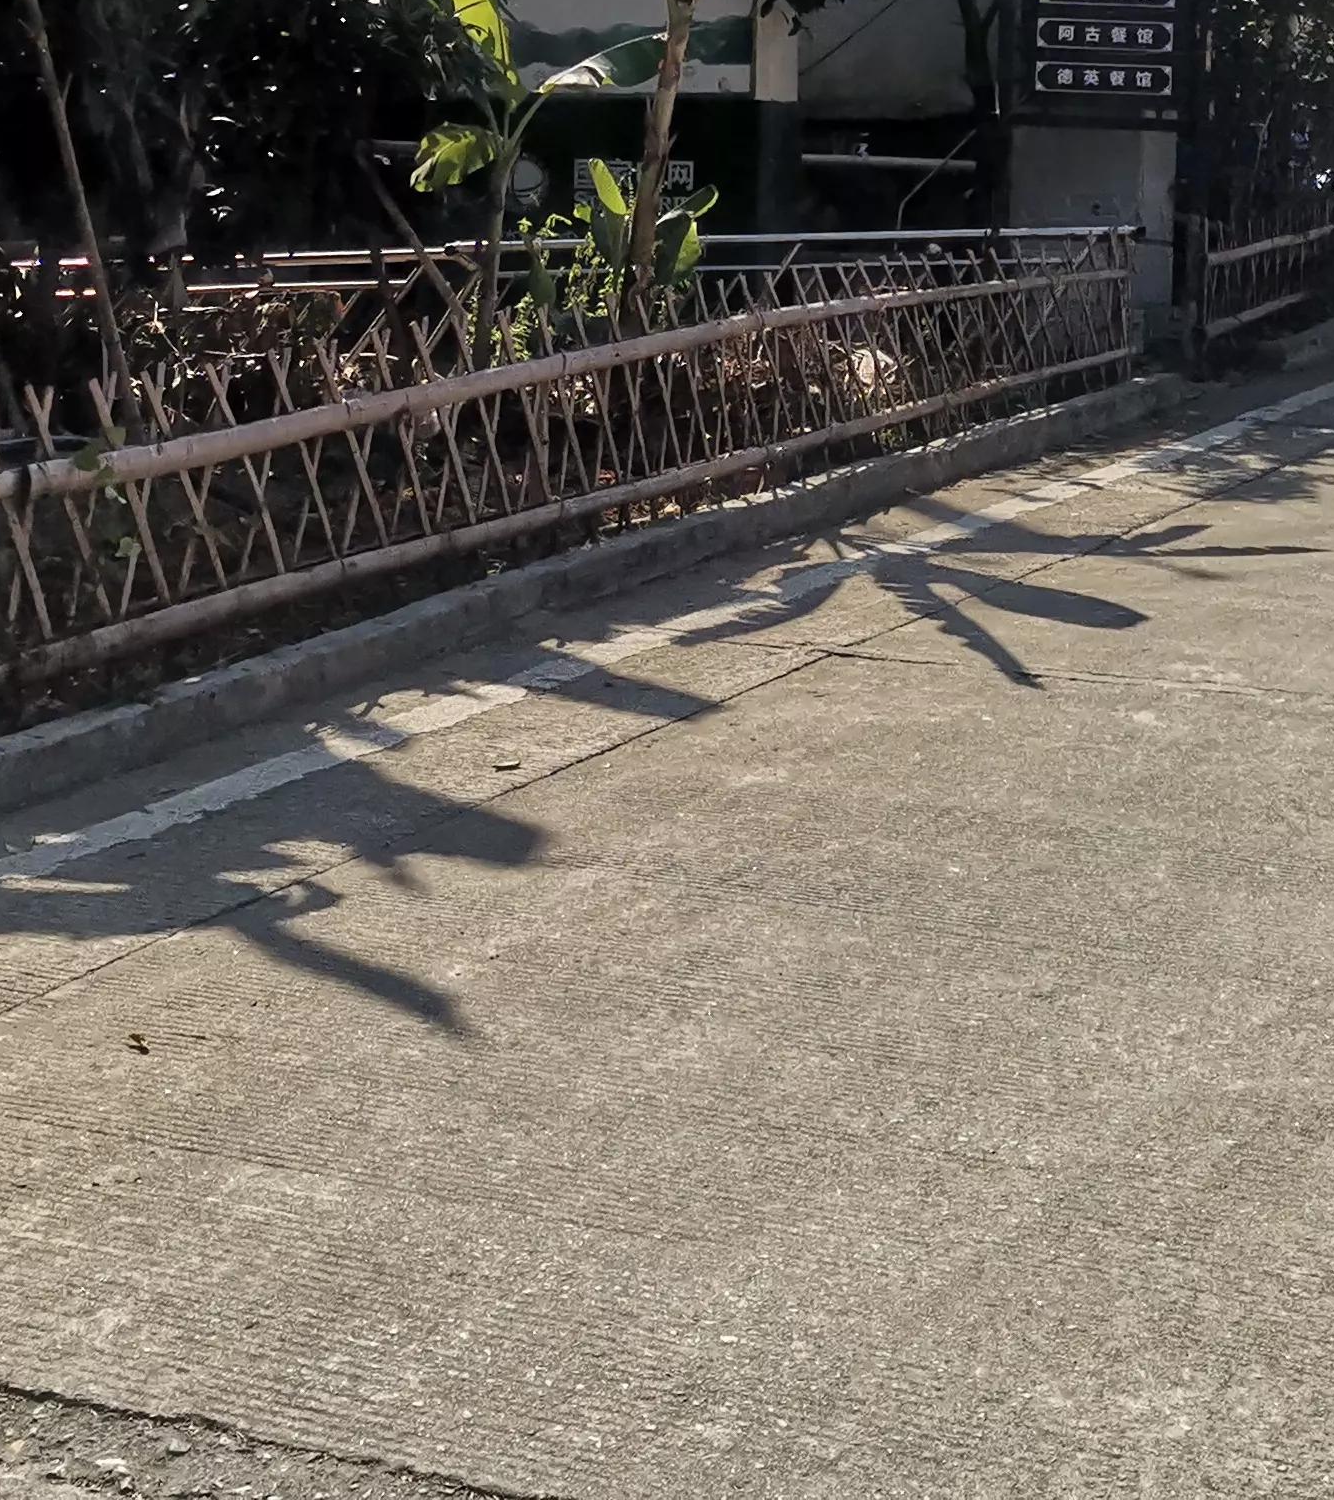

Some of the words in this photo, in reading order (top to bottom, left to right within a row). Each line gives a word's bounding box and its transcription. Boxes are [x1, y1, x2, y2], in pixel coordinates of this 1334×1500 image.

[1057, 24, 1154, 44] 阿古餐馆
[1056, 67, 1153, 88] 德英餐馆
[573, 157, 695, 191] 国家网
